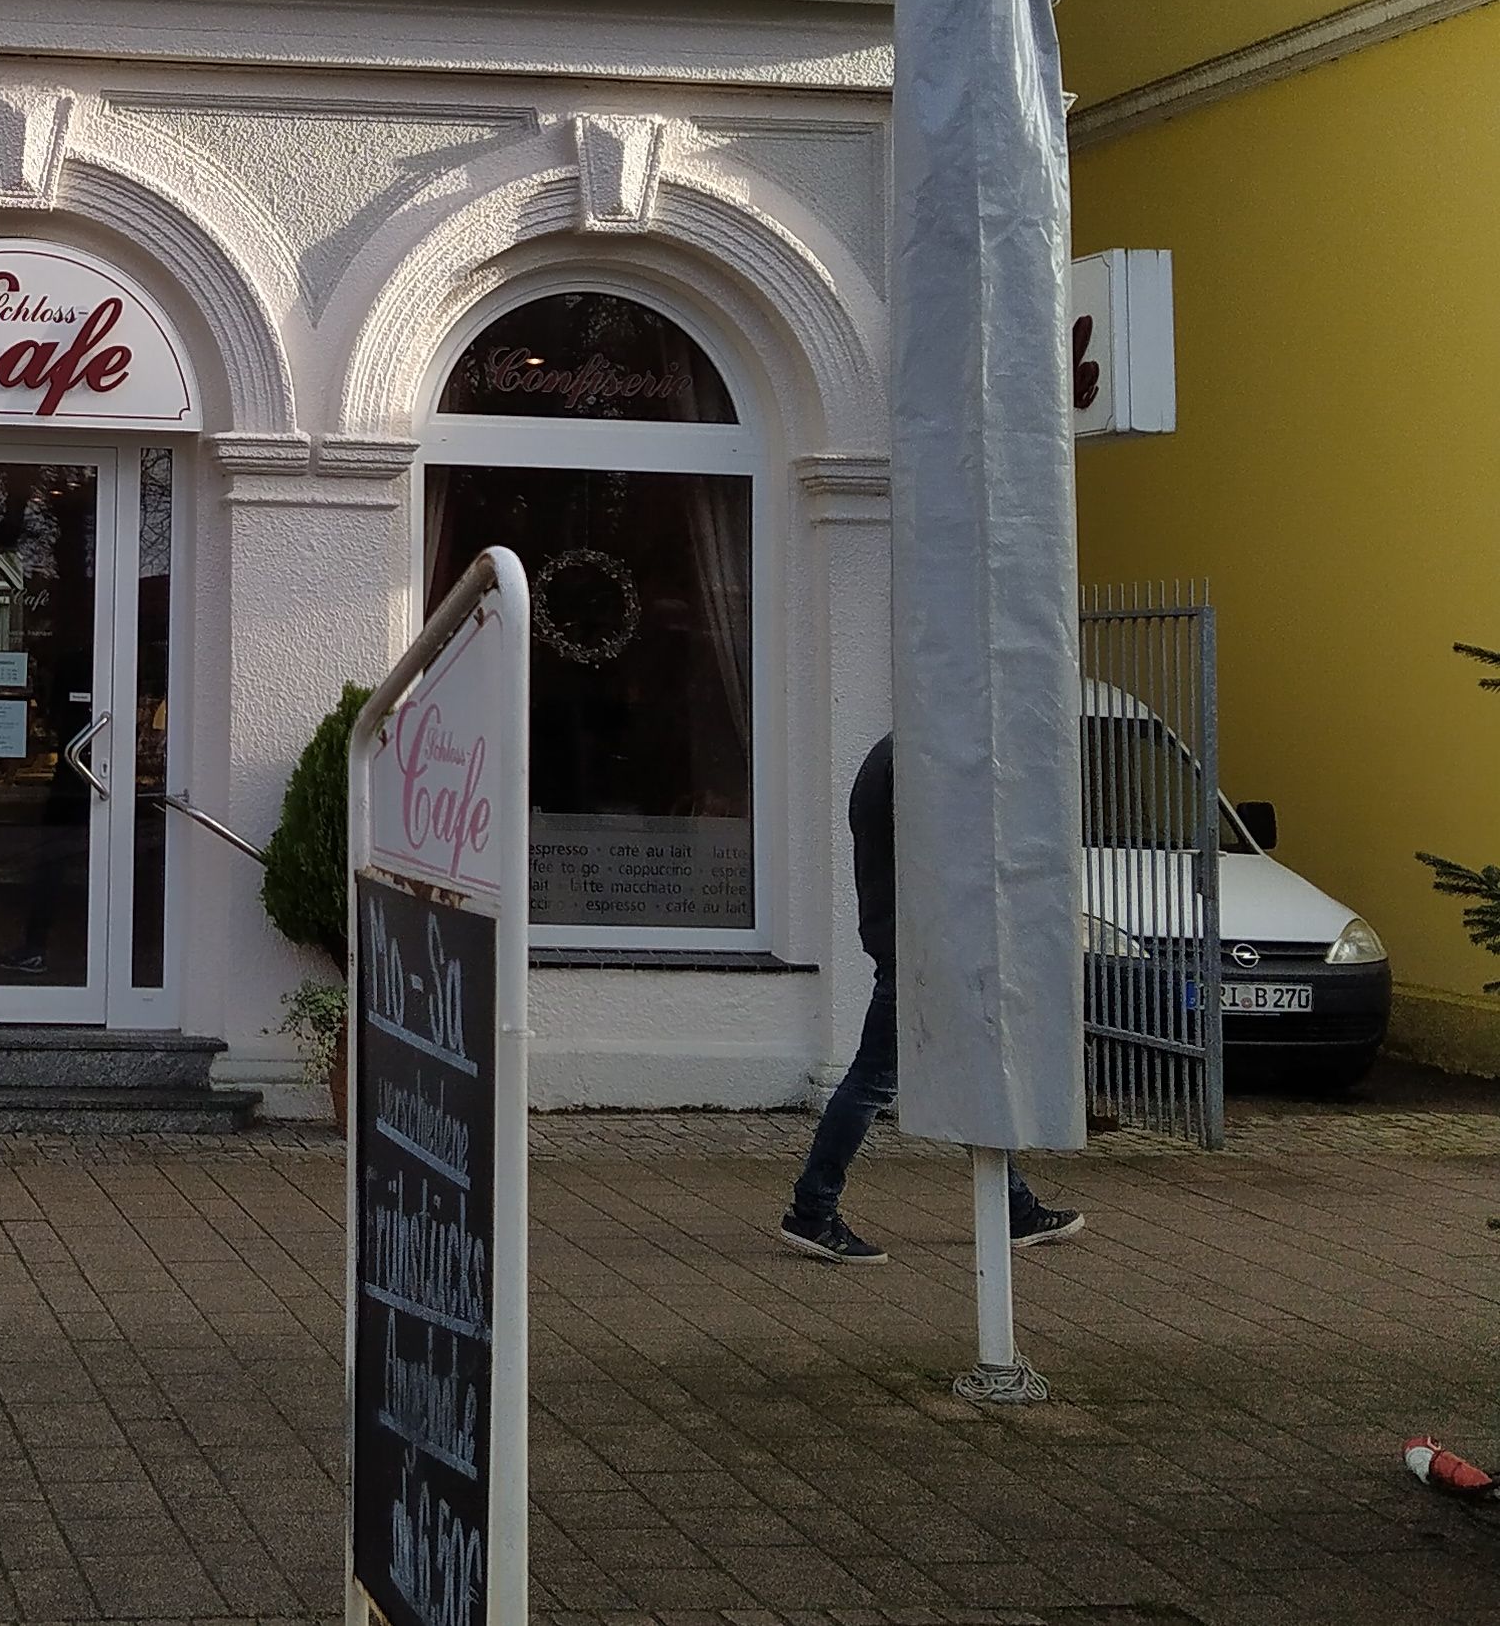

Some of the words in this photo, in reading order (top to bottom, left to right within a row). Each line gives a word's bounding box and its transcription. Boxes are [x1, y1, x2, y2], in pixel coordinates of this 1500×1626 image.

[488, 346, 694, 408] Confiserie
[396, 701, 491, 877] Cafe
[529, 845, 589, 859] espresso
[646, 845, 664, 858] au
[670, 844, 692, 858] lait
[581, 863, 599, 878] go
[611, 879, 682, 895] macchiato
[586, 899, 646, 915] espresso
[703, 901, 720, 914] au
[1255, 987, 1268, 1006] B
[1273, 987, 1311, 1009] 270
